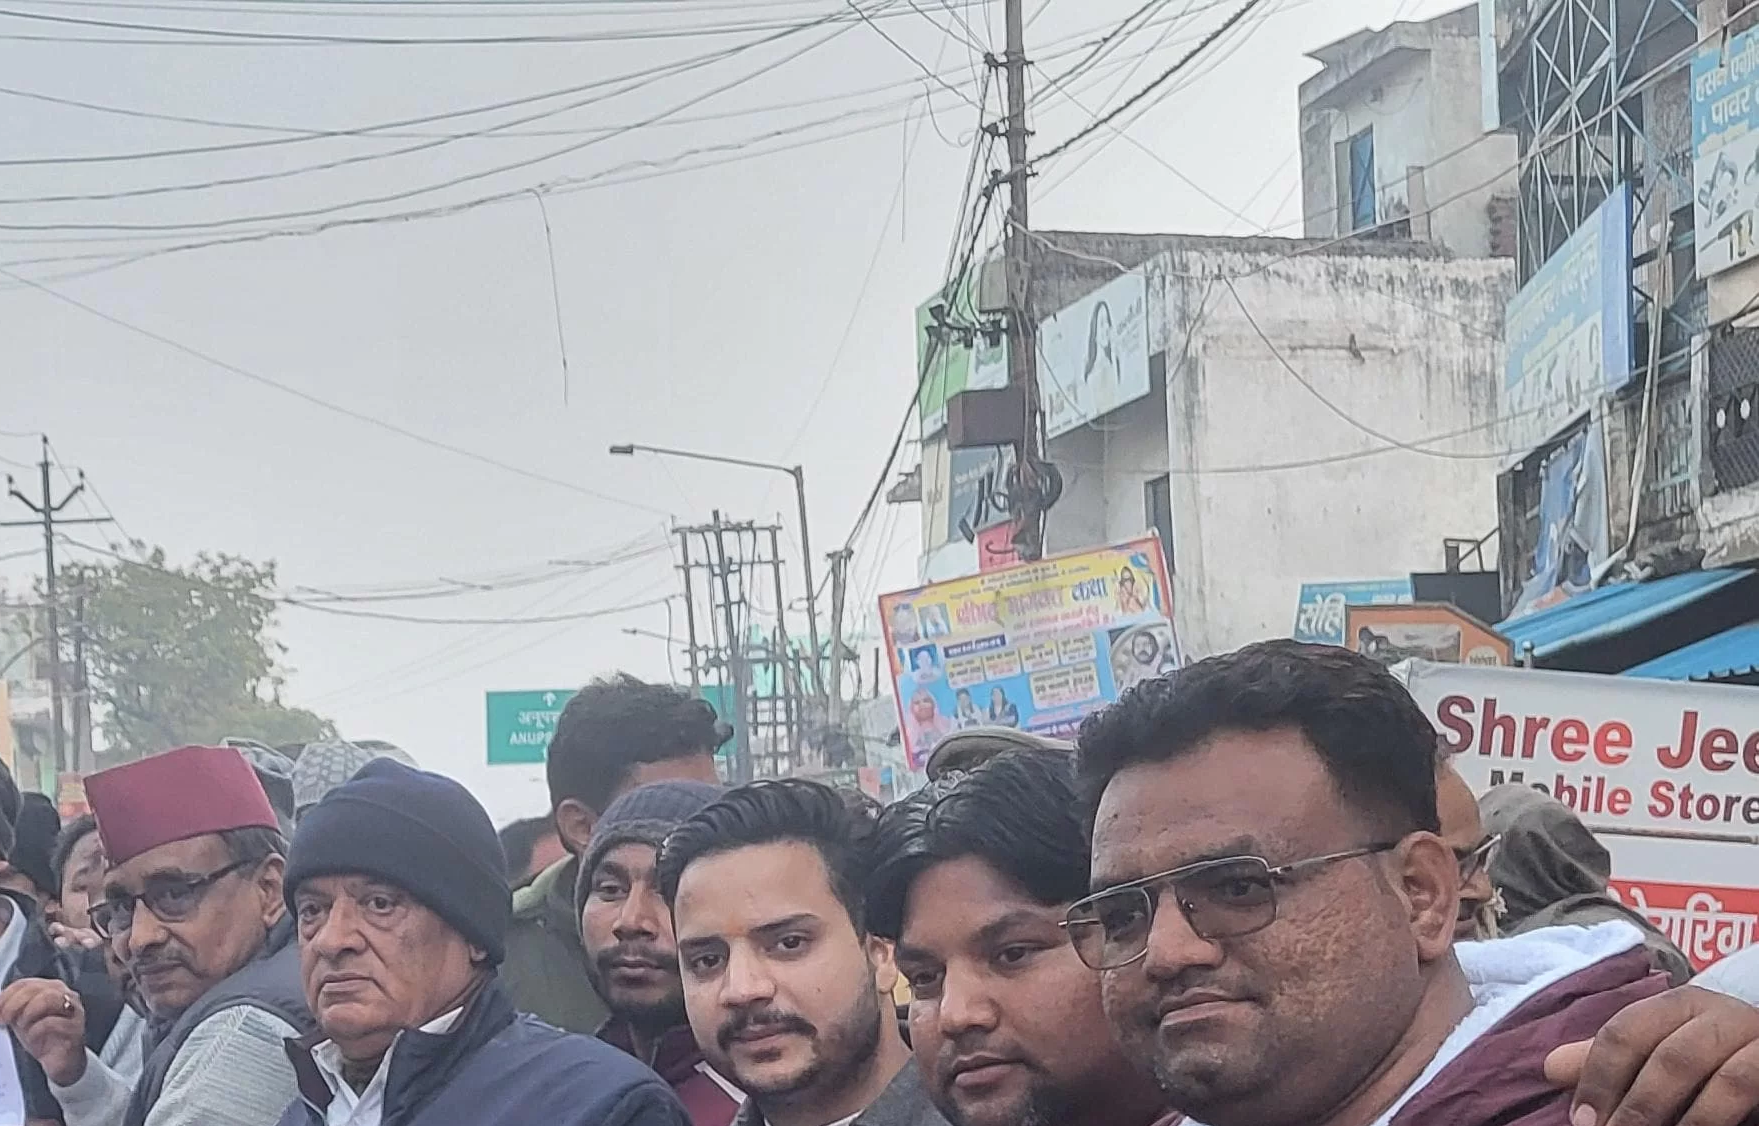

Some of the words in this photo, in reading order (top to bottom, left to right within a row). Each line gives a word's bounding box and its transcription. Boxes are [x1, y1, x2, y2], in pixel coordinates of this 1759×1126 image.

[518, 710, 562, 730] अनूप
[1436, 694, 1633, 766] Shree
[1490, 770, 1633, 815] bile
[1648, 780, 1759, 824] Store
